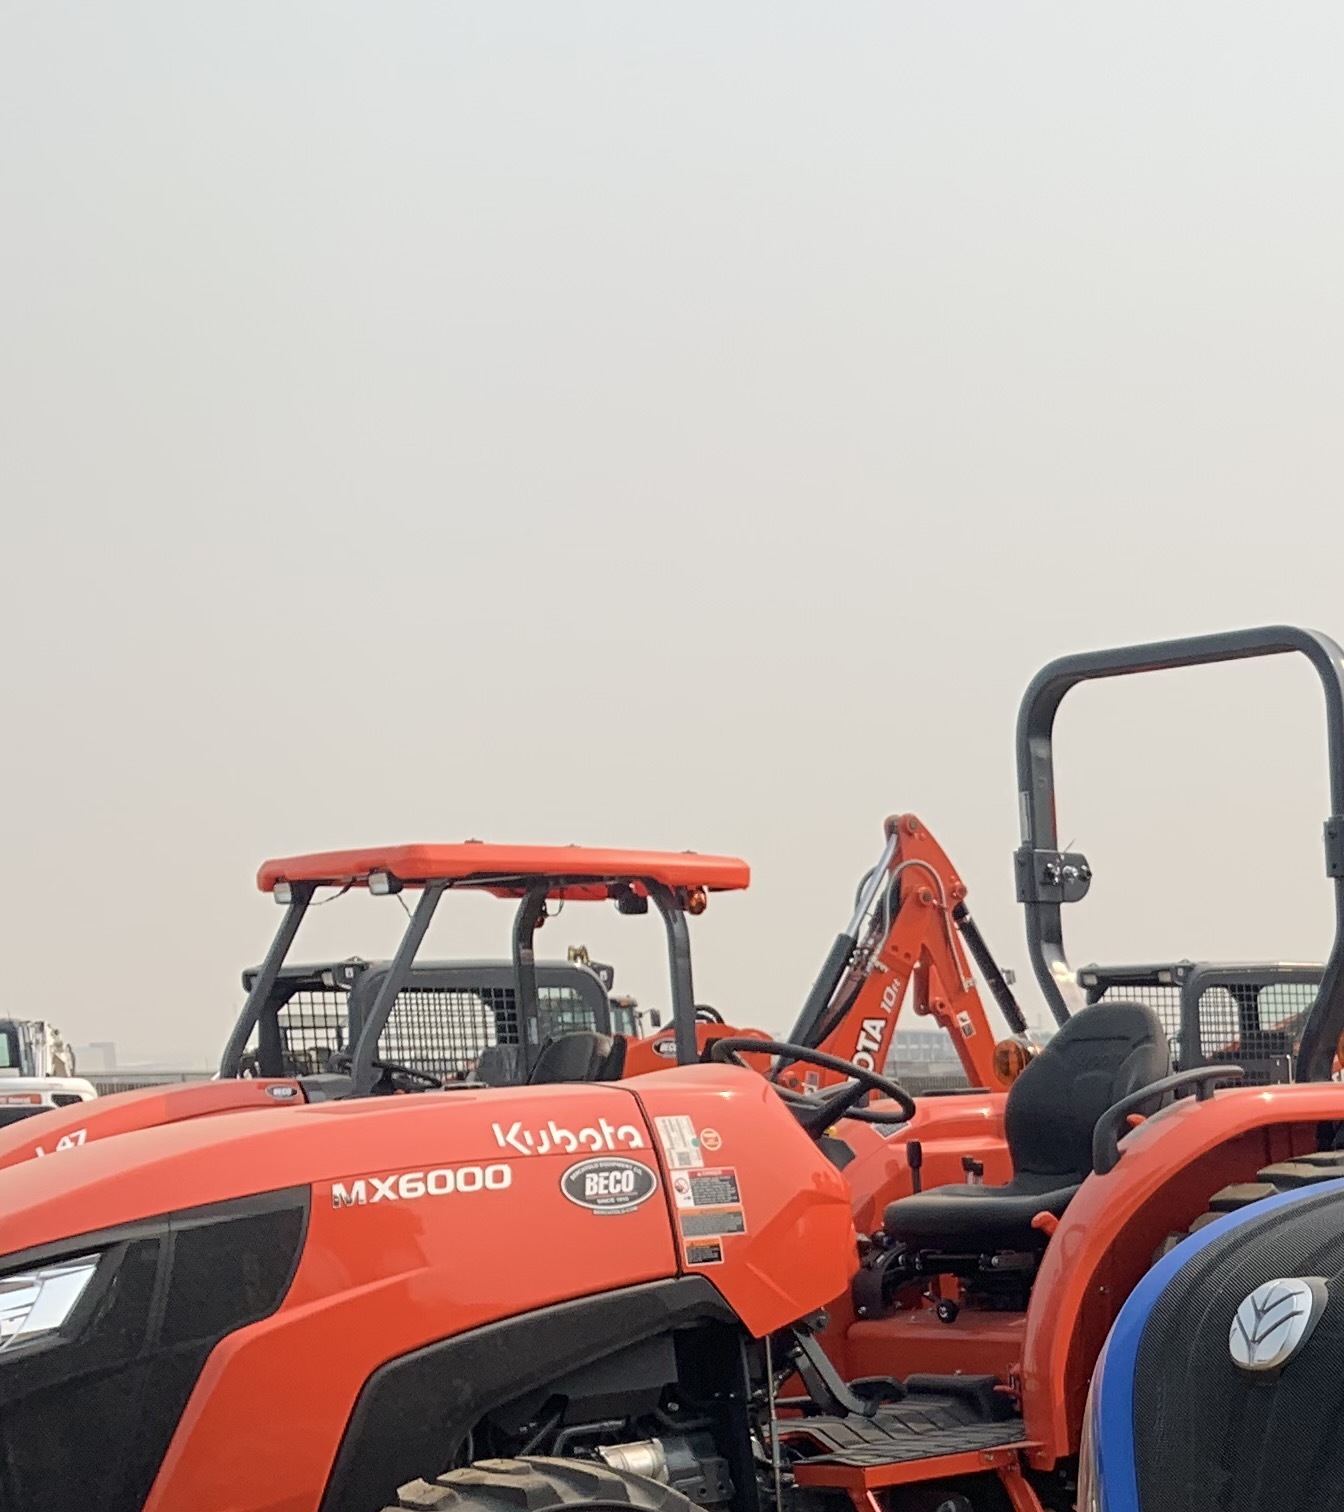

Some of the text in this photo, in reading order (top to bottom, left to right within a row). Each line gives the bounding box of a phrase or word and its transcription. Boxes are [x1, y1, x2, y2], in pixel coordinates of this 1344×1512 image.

[491, 1117, 645, 1156] Kubota
[331, 1163, 513, 1210] MX6000
[585, 1169, 634, 1196] BECO
